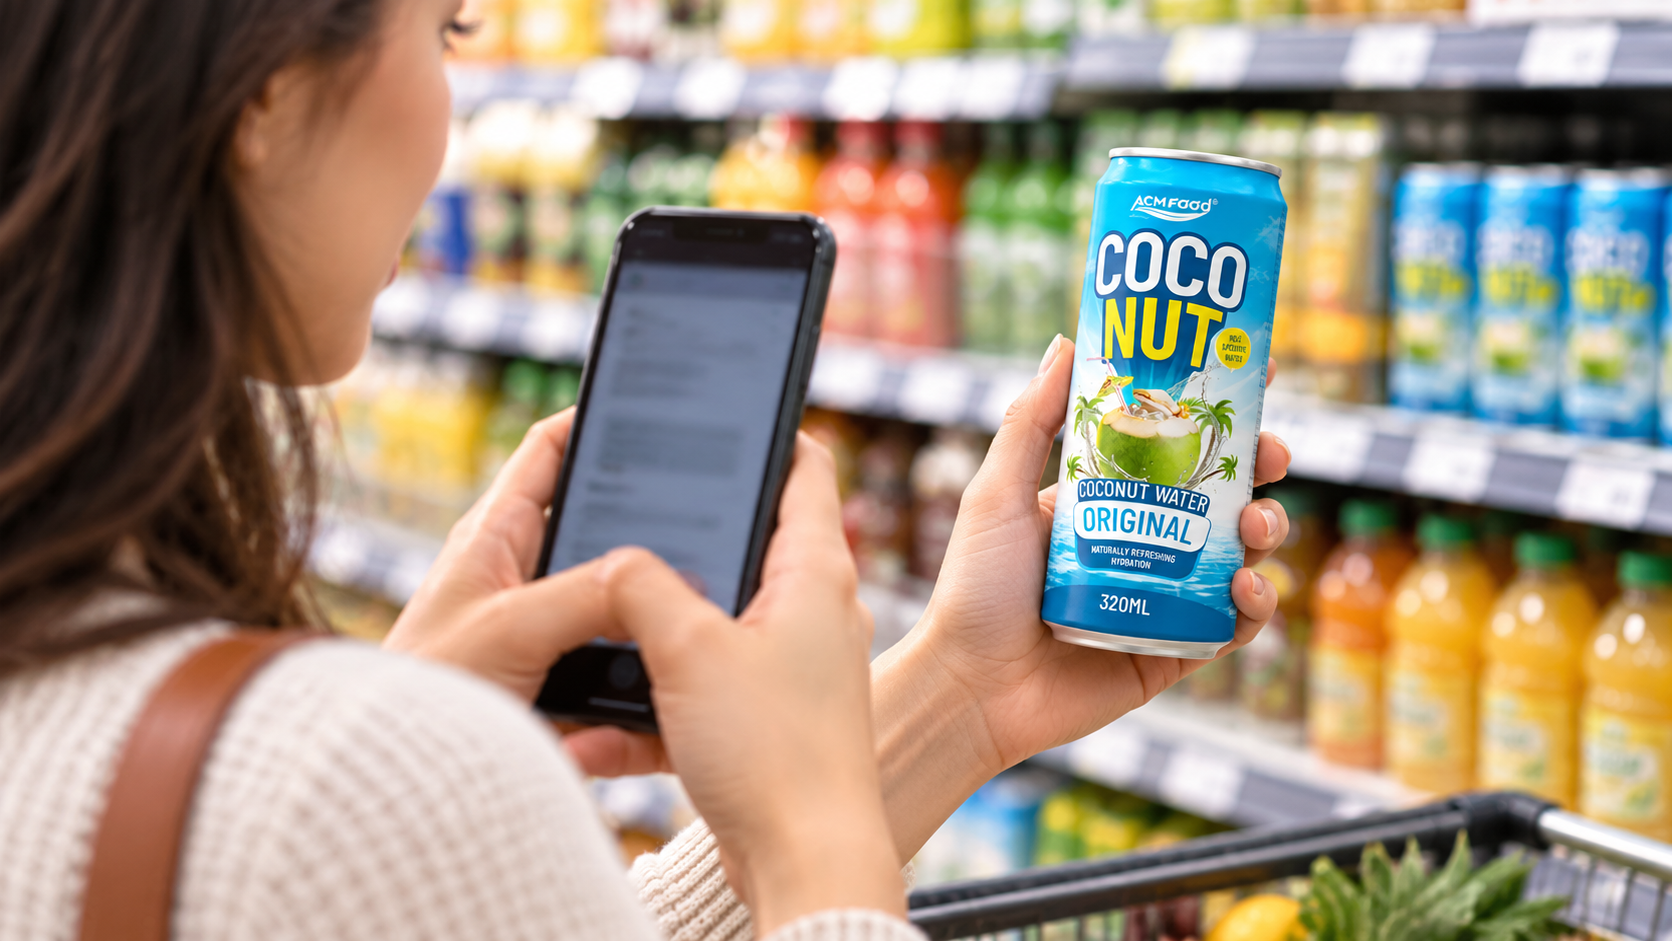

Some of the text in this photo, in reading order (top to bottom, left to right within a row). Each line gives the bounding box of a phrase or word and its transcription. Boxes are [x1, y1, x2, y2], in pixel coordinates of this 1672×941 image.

[1095, 231, 1248, 309] COCO
[1104, 296, 1224, 368] NUT
[1080, 480, 1209, 513] COCONUT WATER
[1083, 506, 1192, 546] ORIGINAL
[1099, 593, 1150, 616] 320ML
